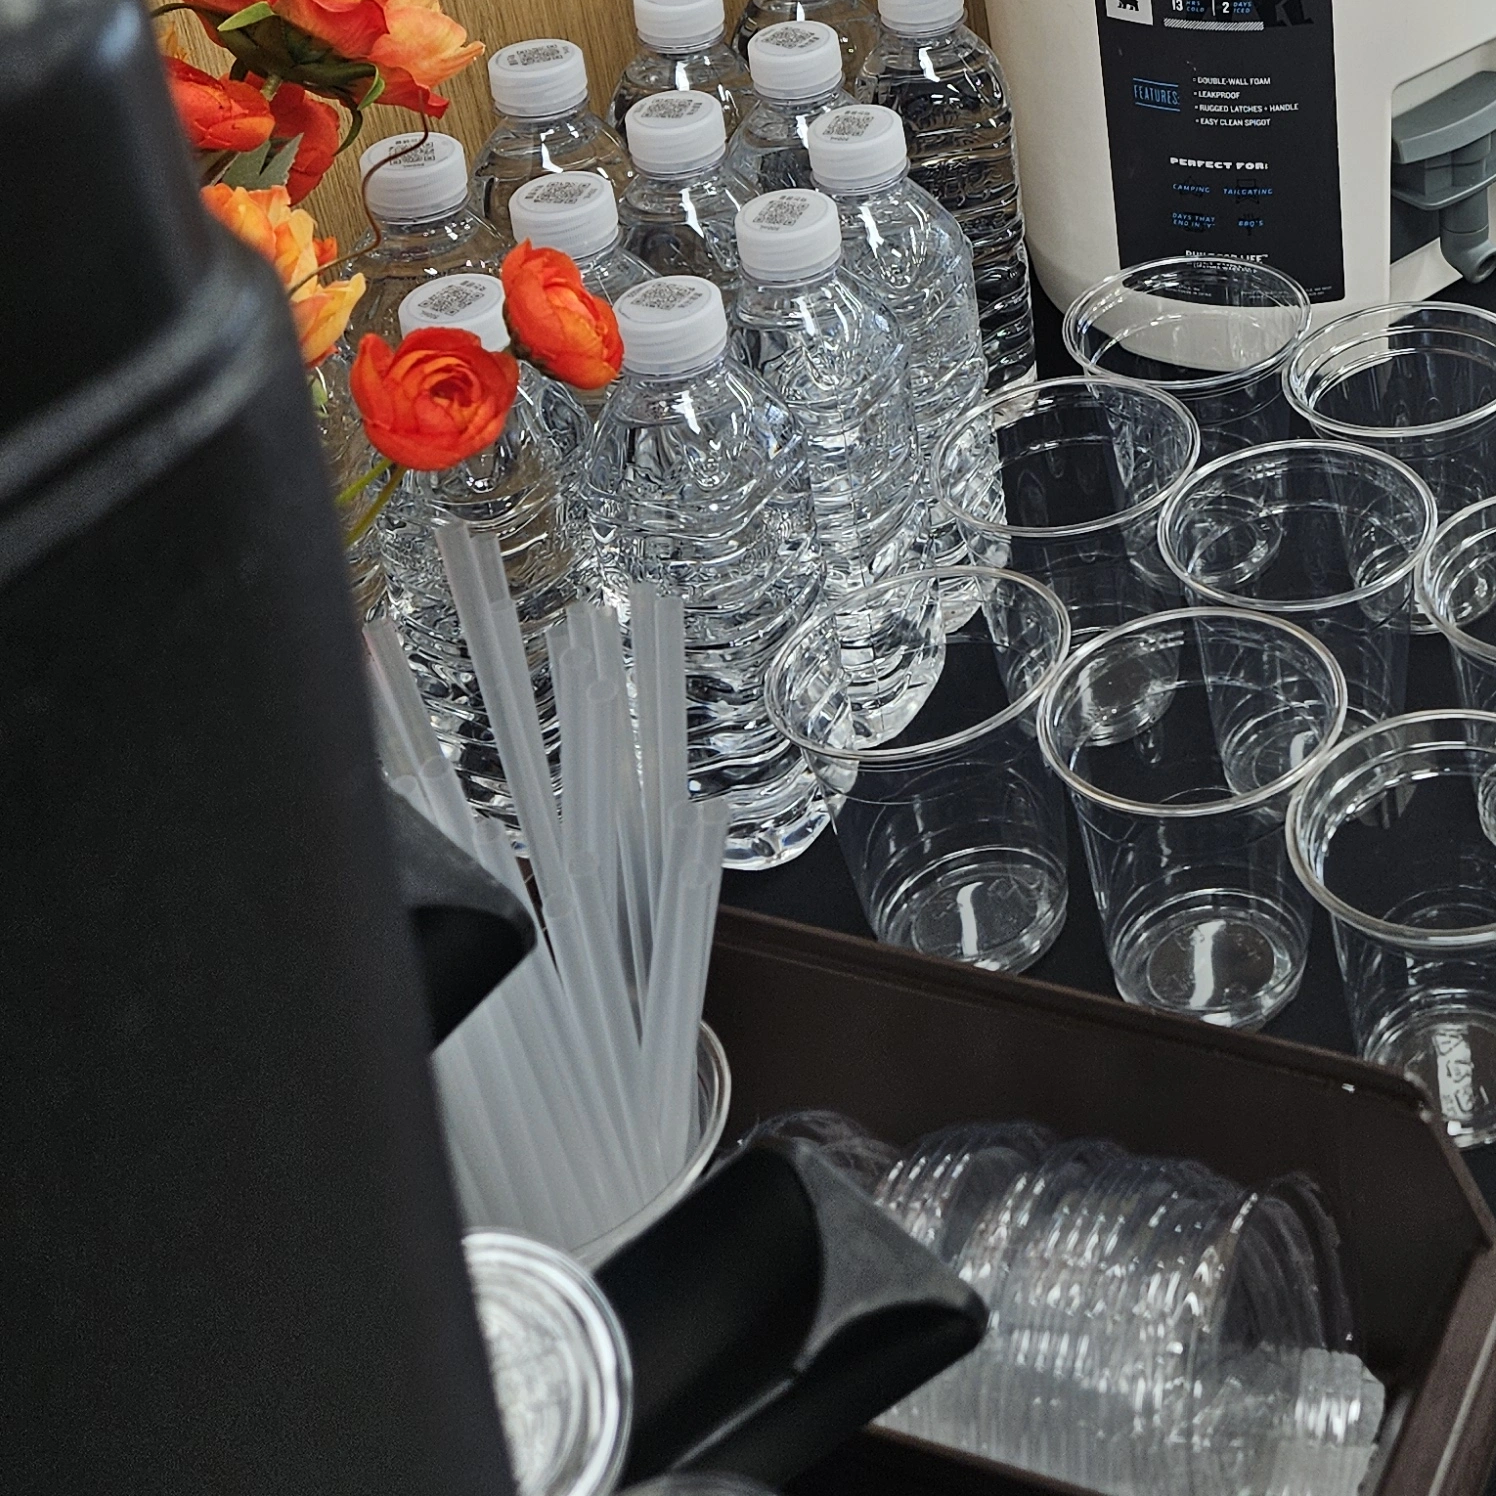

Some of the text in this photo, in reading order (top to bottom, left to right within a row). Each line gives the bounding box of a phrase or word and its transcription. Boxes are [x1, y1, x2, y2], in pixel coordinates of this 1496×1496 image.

[1222, 1, 1230, 14] 2
[1198, 76, 1271, 86] DOUBLE-WALL FOAM
[1198, 90, 1241, 100] LEAKPROOF
[1199, 103, 1229, 113] RUGGED
[1230, 104, 1263, 114] LATCHES
[1269, 102, 1299, 113] HANDLE
[1200, 117, 1271, 127] EASY CLEAN SPIGOT
[1169, 157, 1233, 170] PERFECT
[1172, 183, 1210, 194] CAMPING
